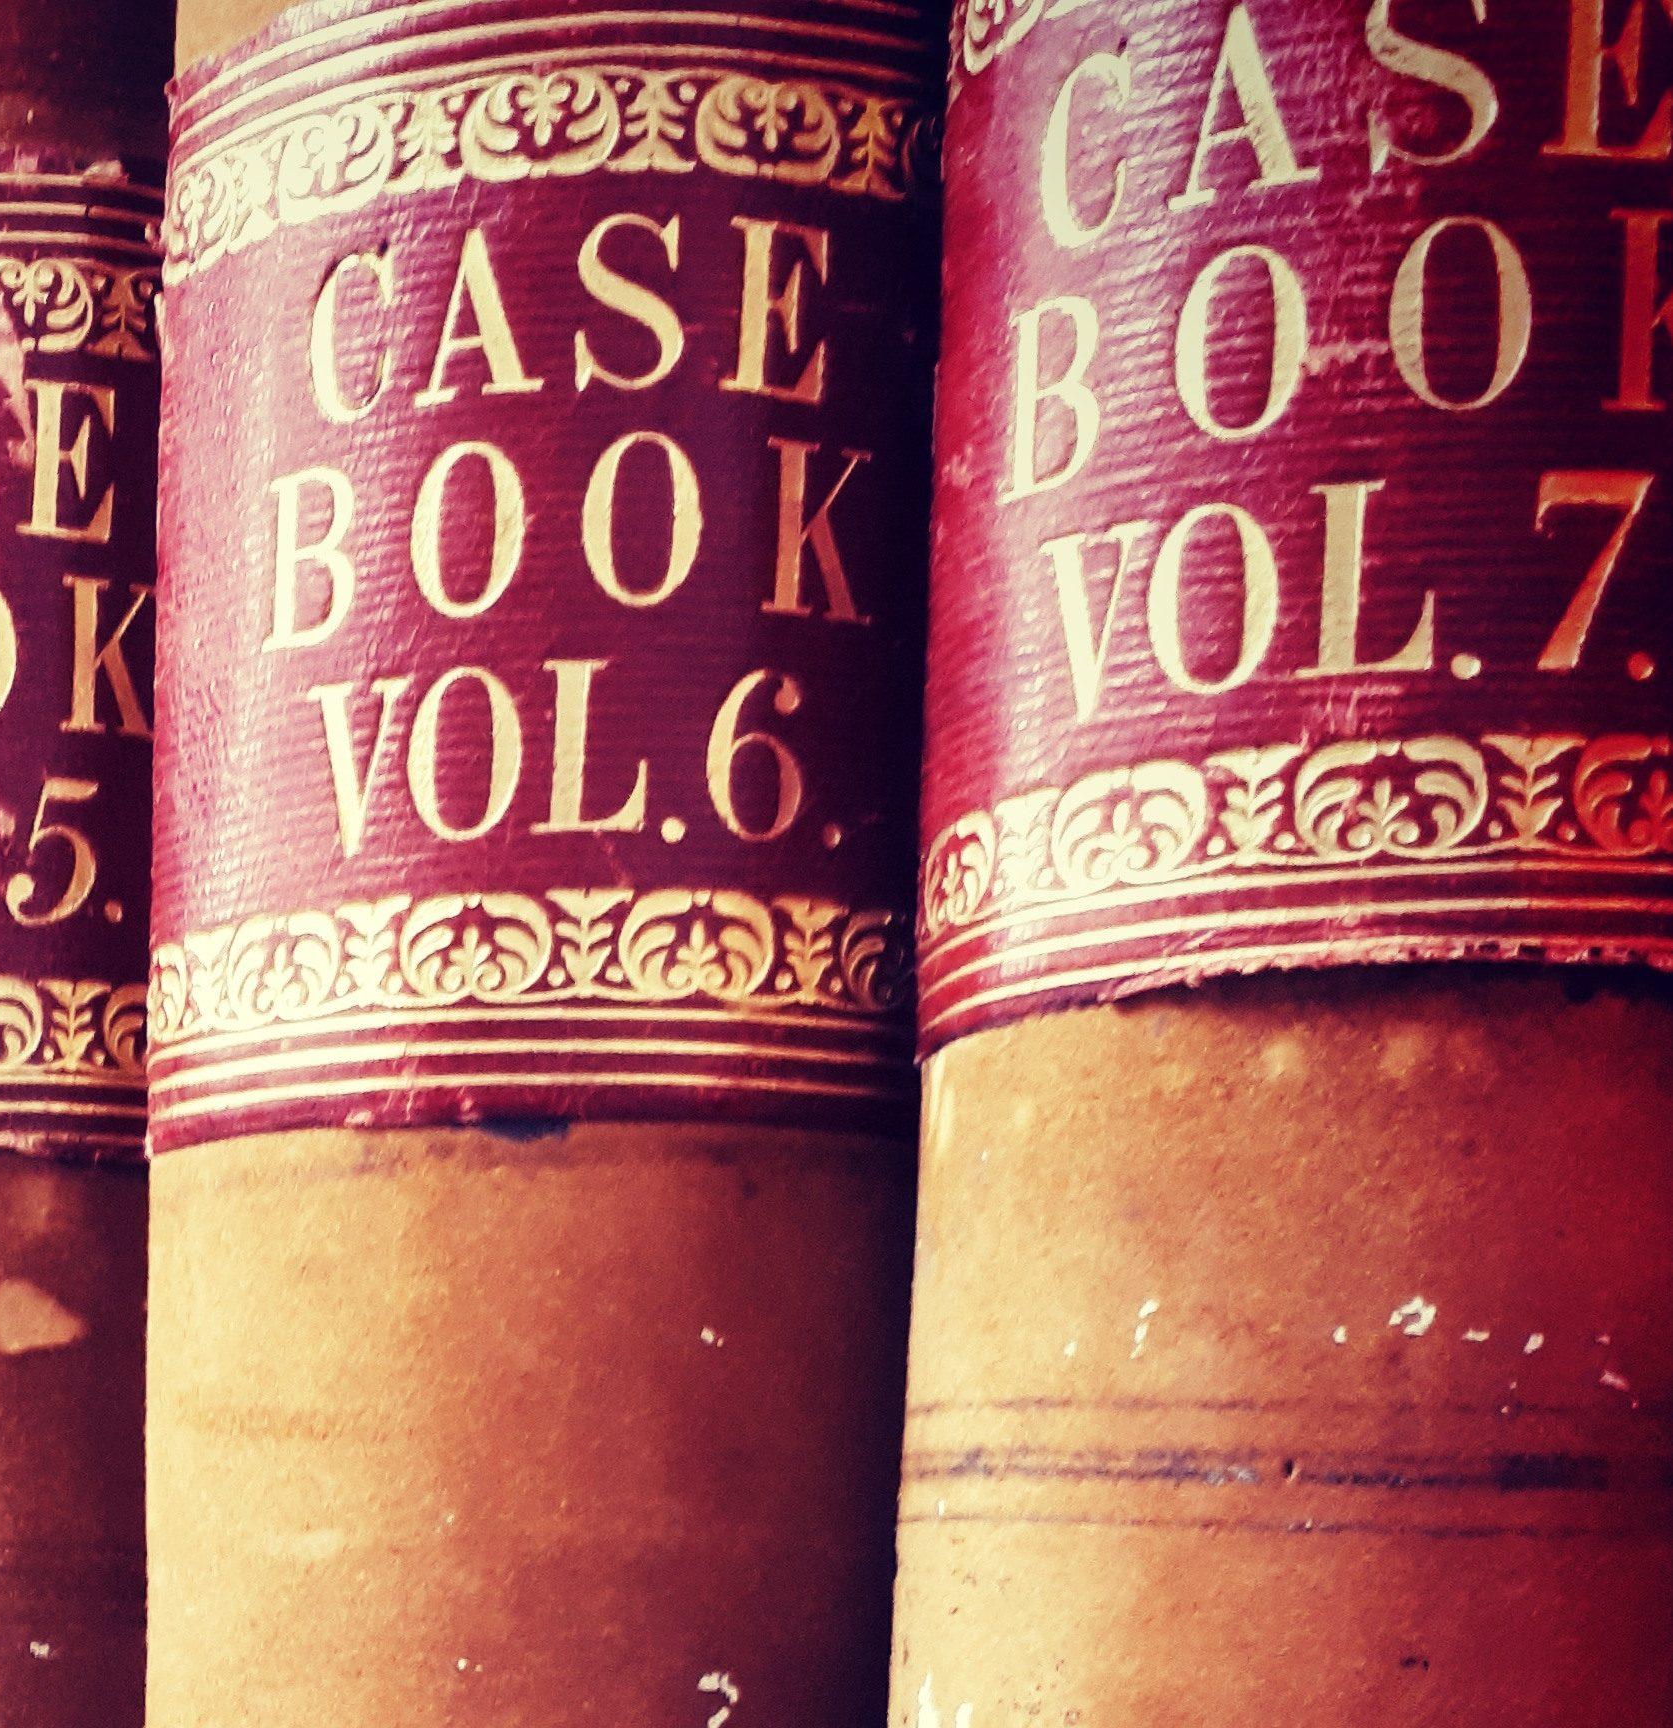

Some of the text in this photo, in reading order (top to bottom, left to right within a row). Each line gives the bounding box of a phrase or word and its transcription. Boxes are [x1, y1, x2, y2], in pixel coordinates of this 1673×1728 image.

[1038, 0, 1673, 251] CASE
[308, 211, 831, 425] CASE
[259, 429, 873, 655] BOOK
